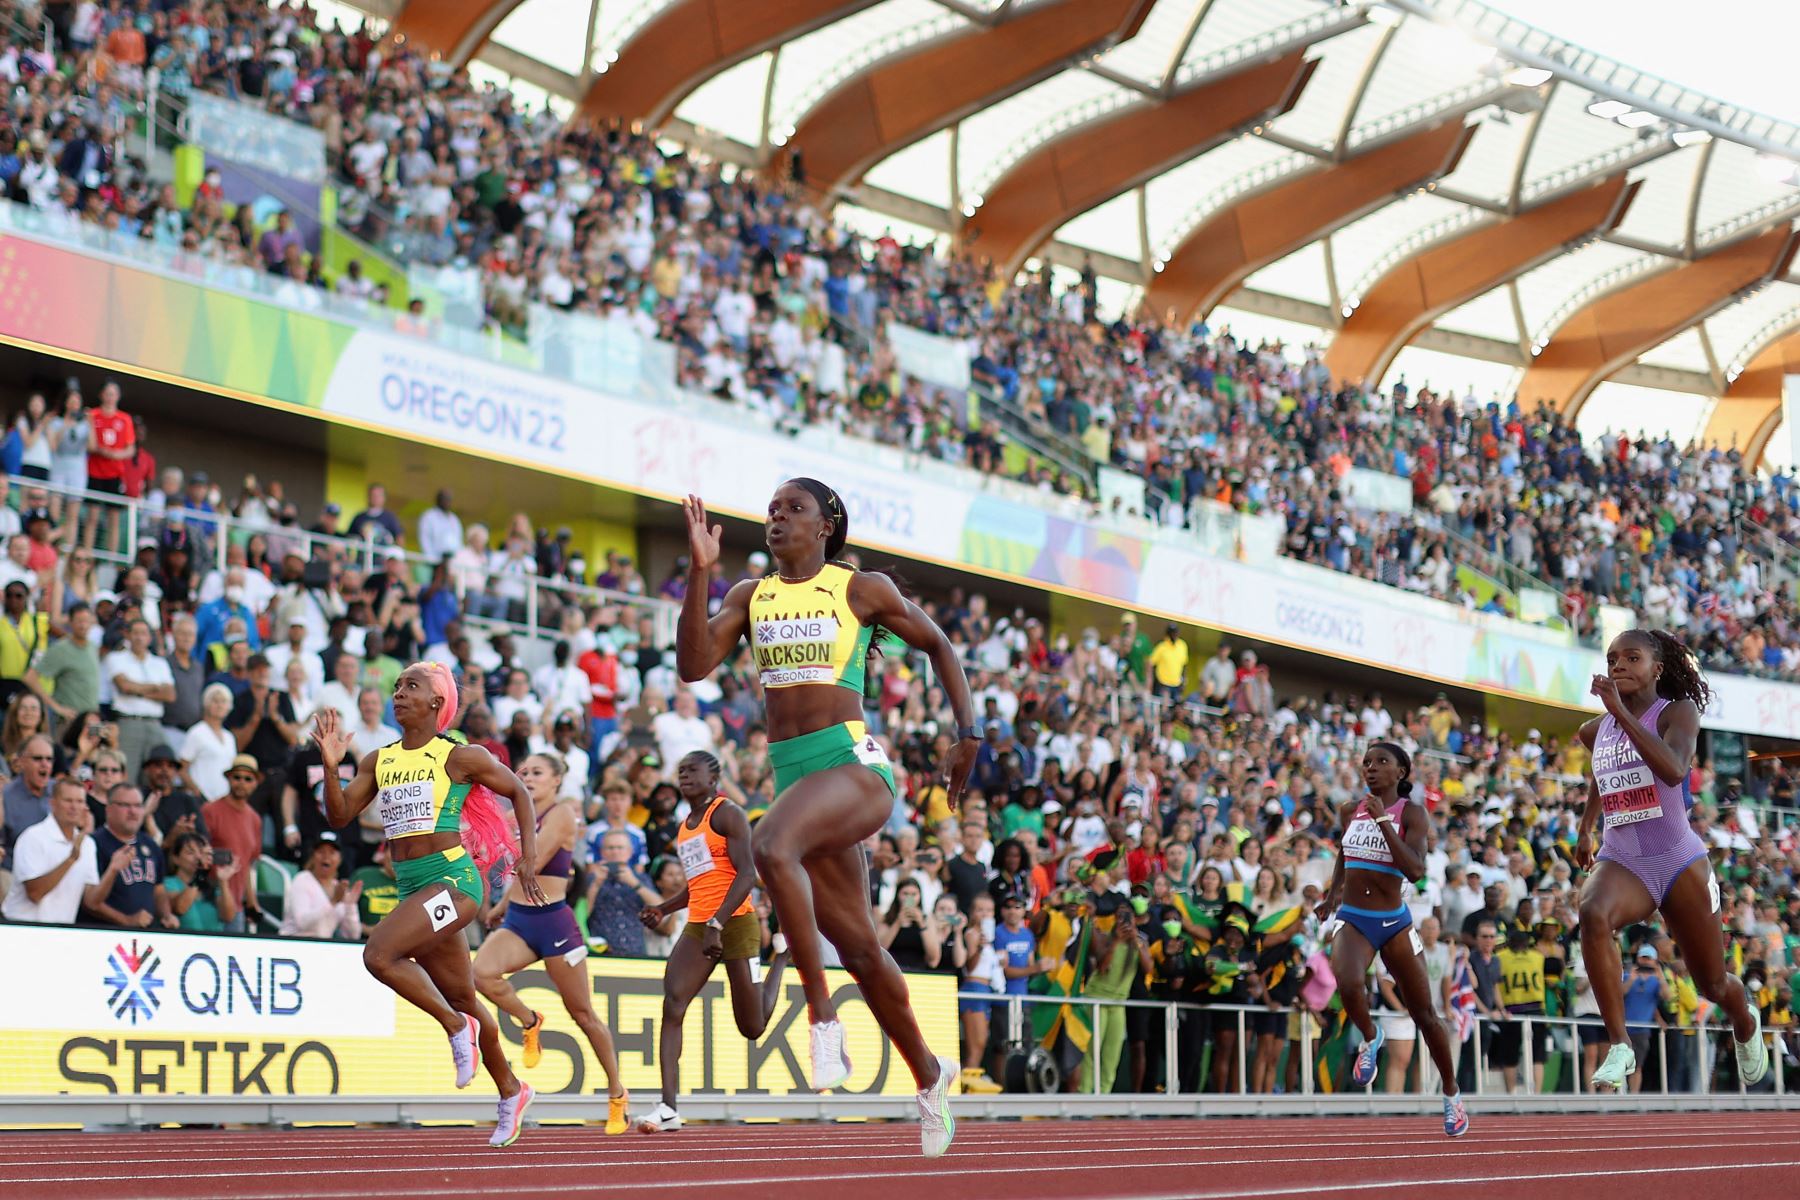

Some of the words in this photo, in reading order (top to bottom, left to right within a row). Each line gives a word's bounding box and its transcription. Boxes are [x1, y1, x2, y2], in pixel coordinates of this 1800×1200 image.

[380, 373, 568, 452] OREGON22
[780, 623, 822, 639] QNB
[759, 643, 830, 667] JACKSON
[1594, 740, 1630, 758] GREA
[380, 768, 435, 787] JAMAICA
[1609, 772, 1642, 789] QNB
[394, 785, 422, 801] QNB
[1603, 787, 1656, 812] HER-SMITH
[380, 801, 431, 824] FRASER-PRYCE
[1606, 811, 1650, 825] REGON22
[1366, 823, 1381, 832] QN
[1348, 834, 1387, 850] CLARK
[120, 858, 156, 885] USA
[434, 904, 451, 921] 6
[180, 953, 303, 1015] QNB
[59, 1036, 339, 1095] SEIKO
